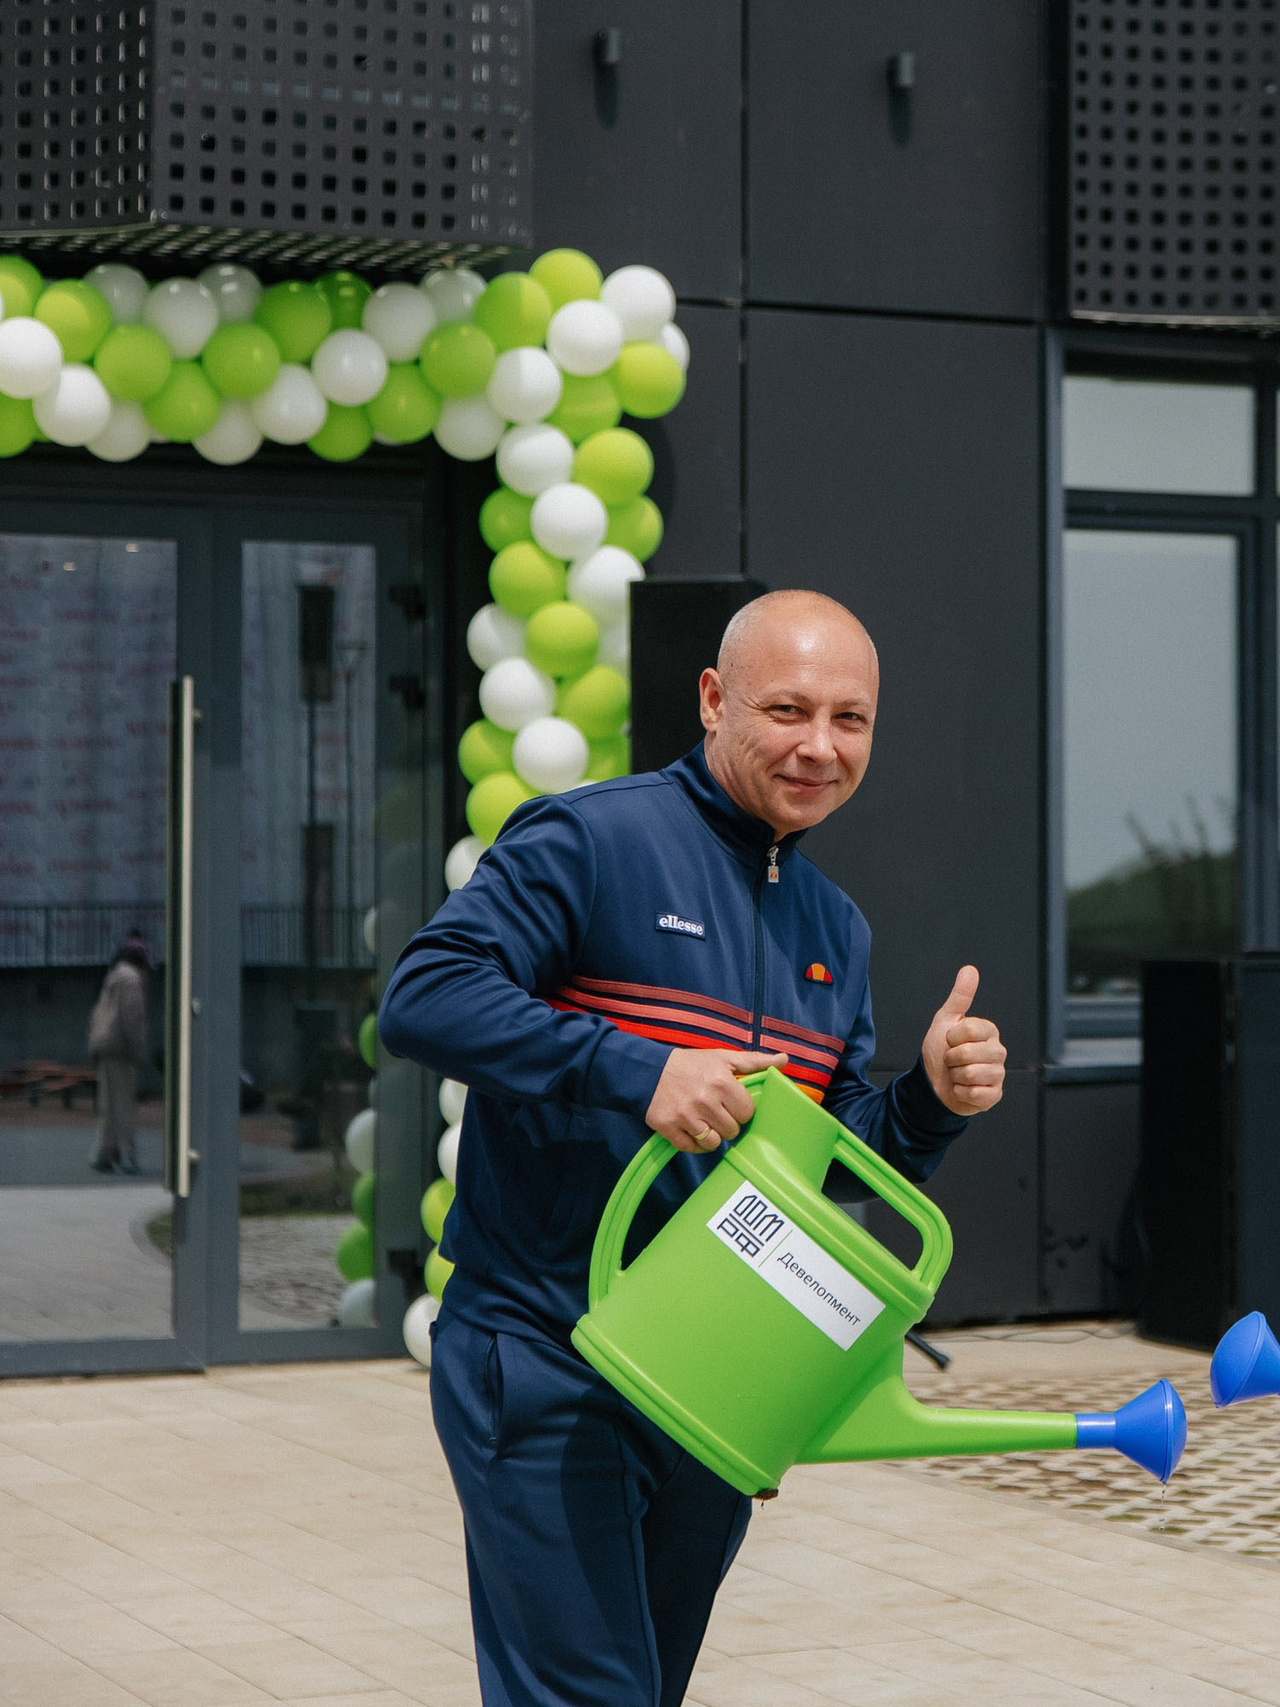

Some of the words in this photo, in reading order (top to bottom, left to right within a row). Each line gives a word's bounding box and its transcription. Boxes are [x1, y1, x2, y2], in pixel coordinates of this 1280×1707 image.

[659, 915, 703, 935] ellesse
[717, 1217, 761, 1258] РФ
[733, 1195, 785, 1242] ДОМ
[777, 1252, 861, 1326] Девелопмент
